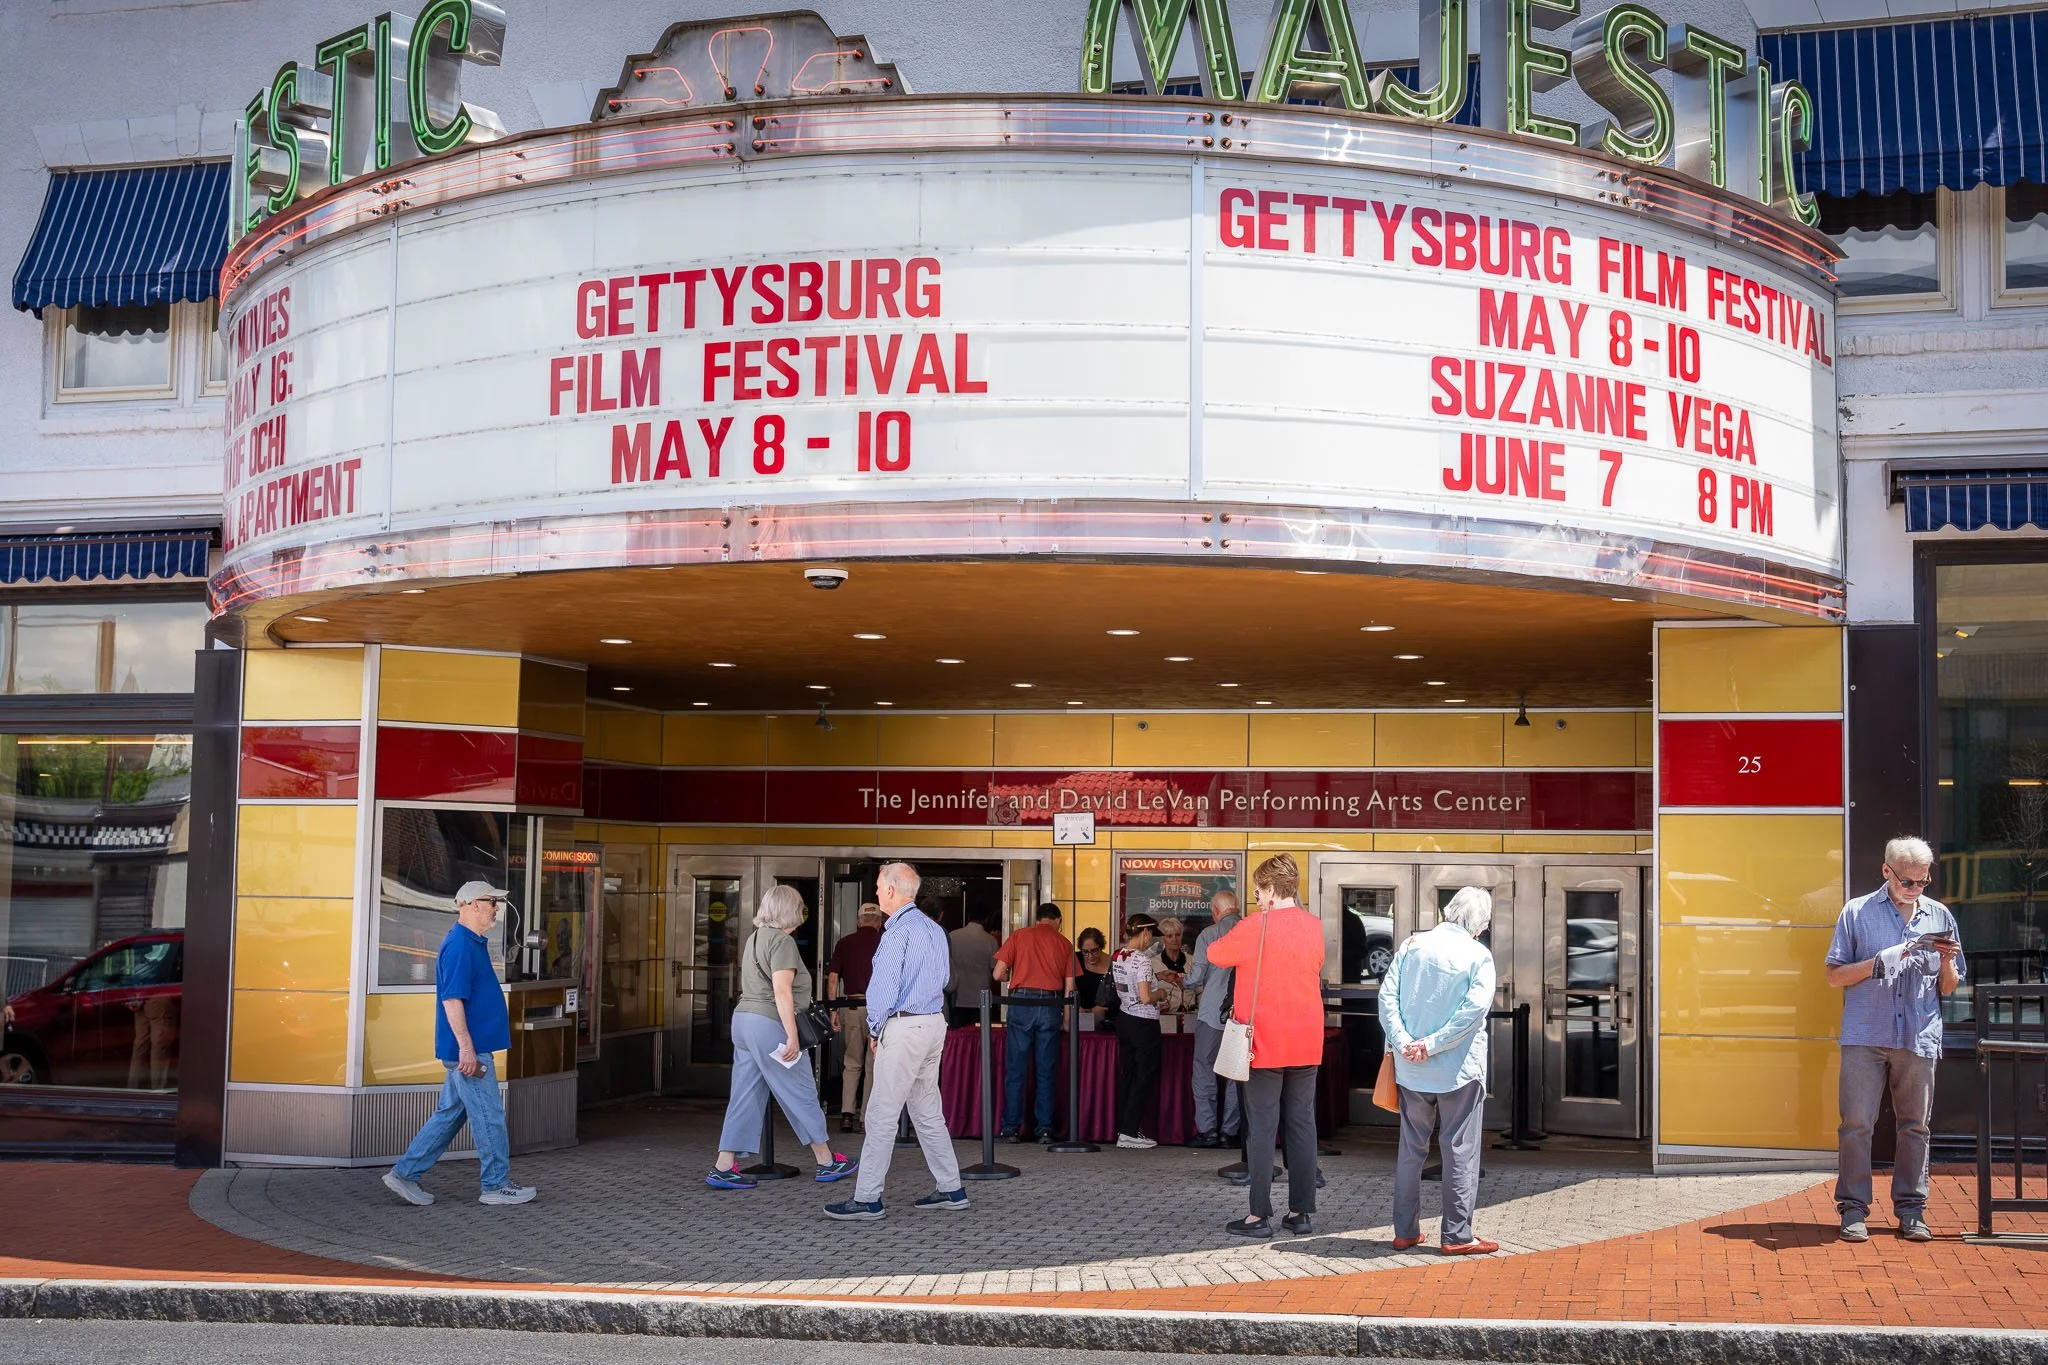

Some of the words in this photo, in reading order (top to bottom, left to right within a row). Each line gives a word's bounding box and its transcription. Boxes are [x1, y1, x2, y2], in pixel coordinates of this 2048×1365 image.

[1082, 0, 1821, 228] MAJESTIC
[576, 257, 941, 340] GETTYSBURG
[1220, 189, 1571, 285] GETTYSBURG
[1599, 237, 1686, 311] FILM
[1707, 267, 1832, 368] FESTIVAL
[237, 286, 290, 368] MOVIES
[1480, 288, 1589, 358] MAY
[234, 363, 261, 429] MAY
[270, 348, 293, 407] 16:
[551, 347, 661, 416] FILM
[704, 333, 988, 403] FESTIVAL
[1432, 356, 1647, 440] SUZANNE
[1668, 391, 1756, 465] VEGA
[249, 414, 286, 477] OCHI
[612, 417, 733, 484] MAY
[753, 414, 785, 475] 8
[858, 411, 911, 472] 10
[1443, 433, 1565, 501] JUNE
[1600, 450, 1622, 506] 7
[1698, 468, 1717, 523] 8
[1731, 475, 1773, 536] PM
[238, 458, 361, 547] APARTMENT
[859, 788, 901, 808] The
[908, 788, 999, 814] Jennifer
[1009, 789, 1049, 809] and
[1060, 789, 1127, 810] David
[1138, 789, 1209, 811] LeVan
[1220, 789, 1359, 816] Performing
[1367, 790, 1422, 811] Arts
[1434, 789, 1526, 811] Center
[1738, 756, 1761, 773] 25
[542, 850, 574, 861] COMING
[576, 852, 600, 862] SOON
[1122, 859, 1157, 869] NOW
[1162, 859, 1234, 869] SHOWING
[1149, 899, 1178, 910] Bobby
